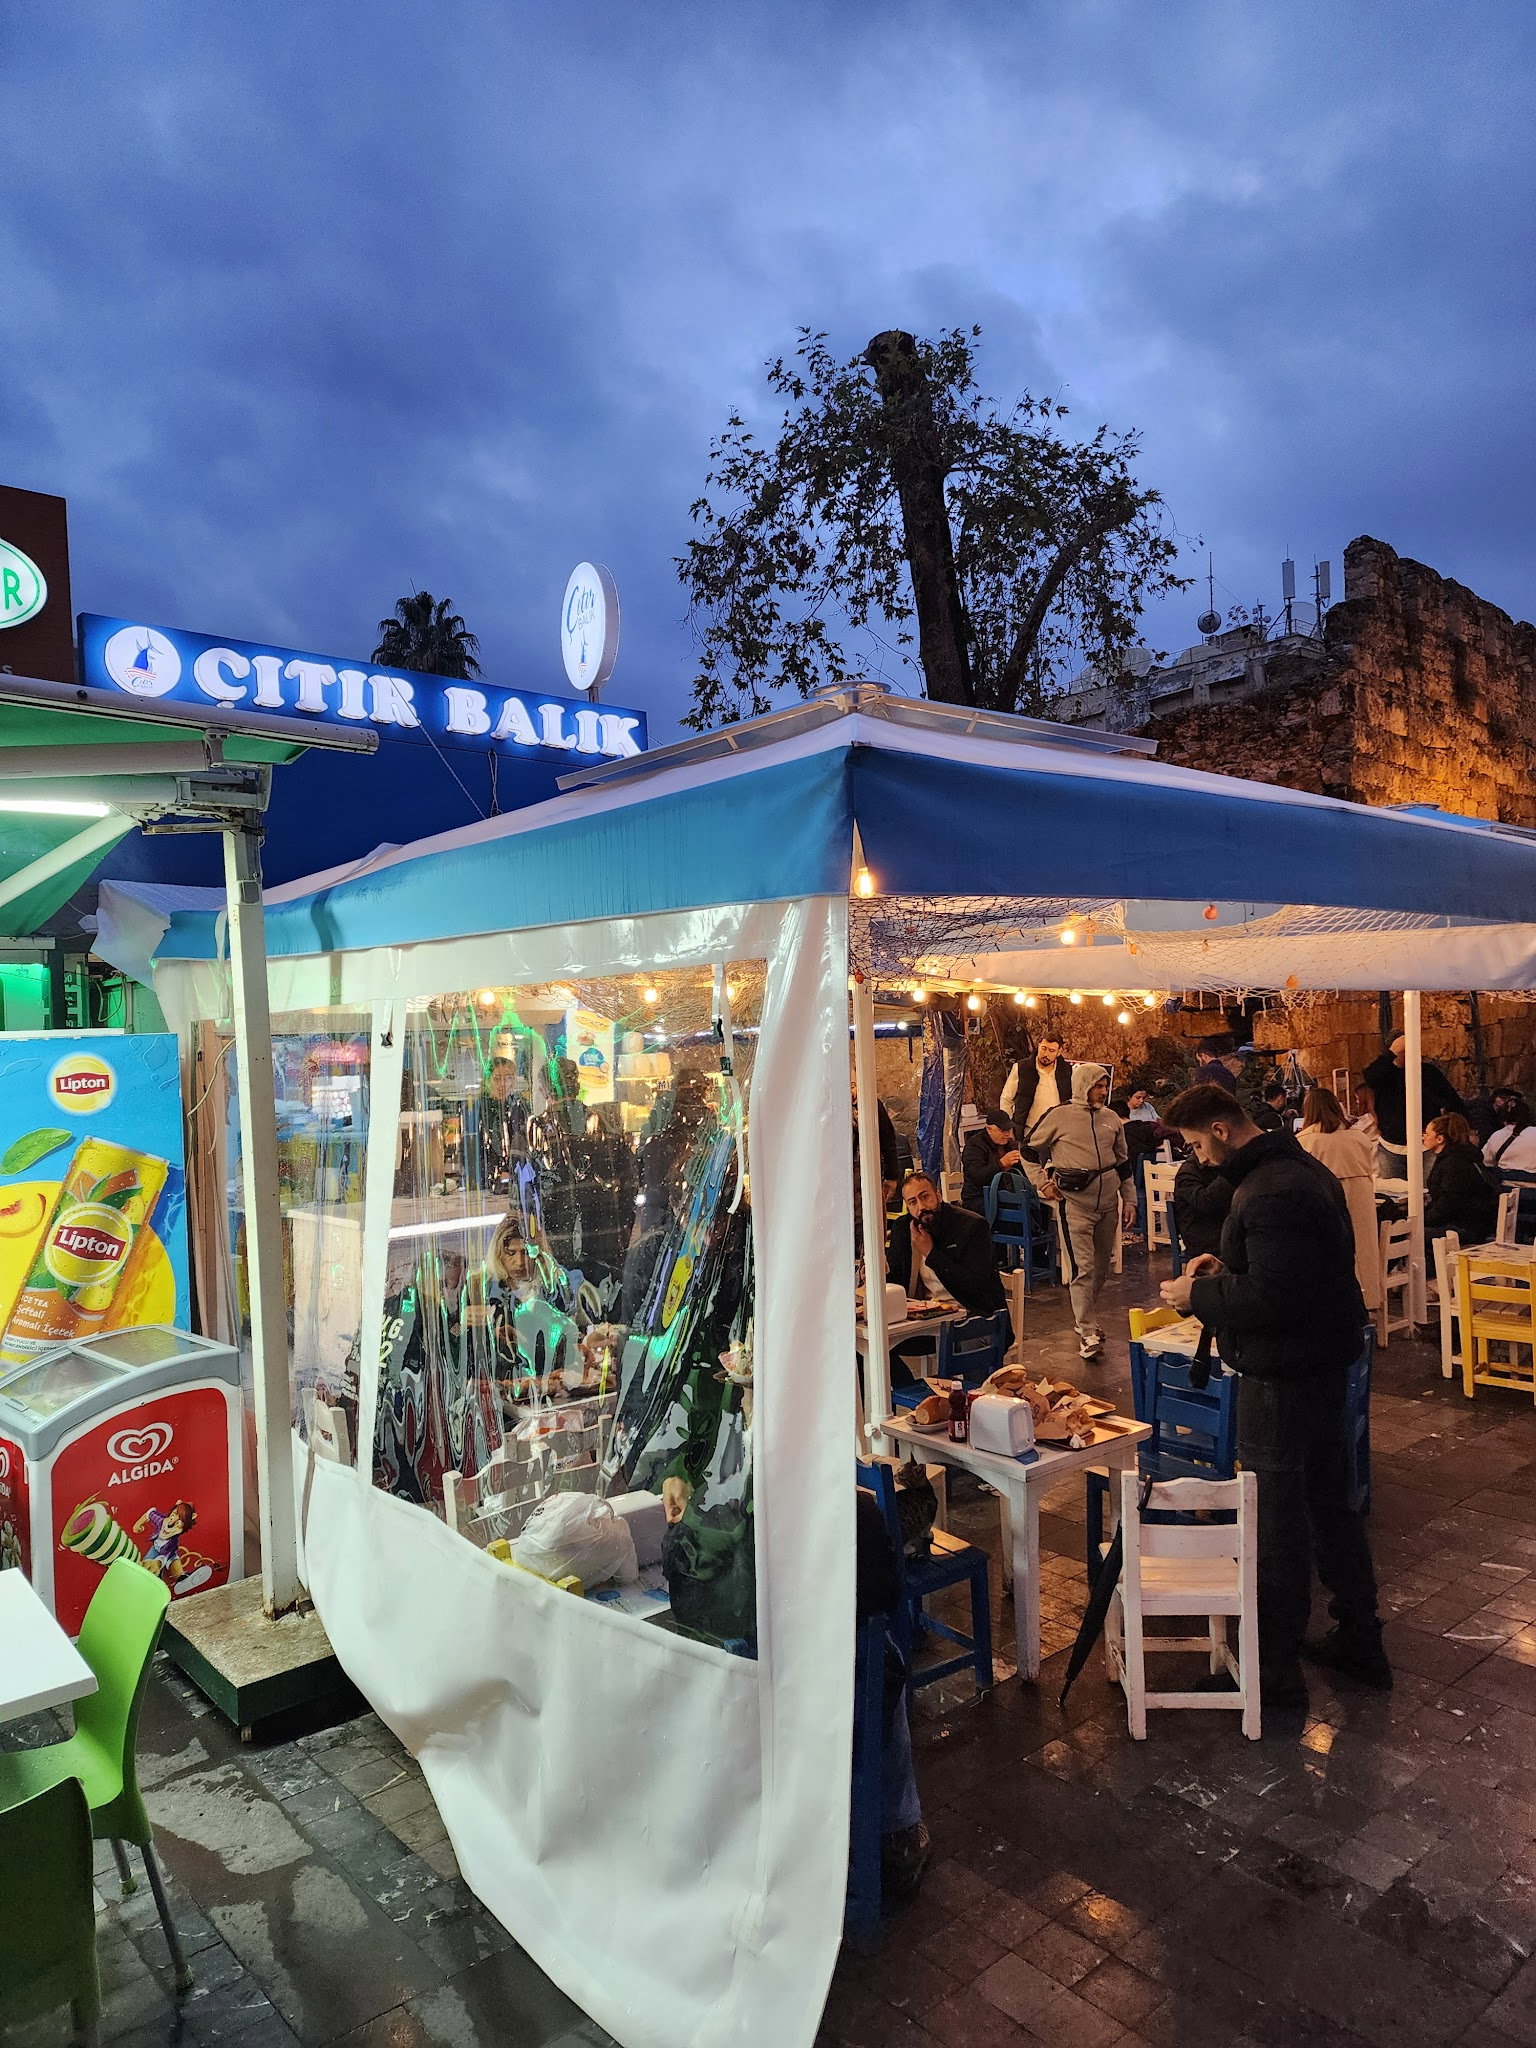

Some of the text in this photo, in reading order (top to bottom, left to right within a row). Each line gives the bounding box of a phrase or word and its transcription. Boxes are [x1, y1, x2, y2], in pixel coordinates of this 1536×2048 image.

[193, 647, 641, 758] ÇITIR BALIK
[59, 1078, 106, 1092] Lipton
[59, 1227, 120, 1257] Lipton
[20, 1294, 49, 1308] ICE TEA
[16, 1304, 46, 1319] Şeftali
[11, 1315, 76, 1338] Aromalı İçecek
